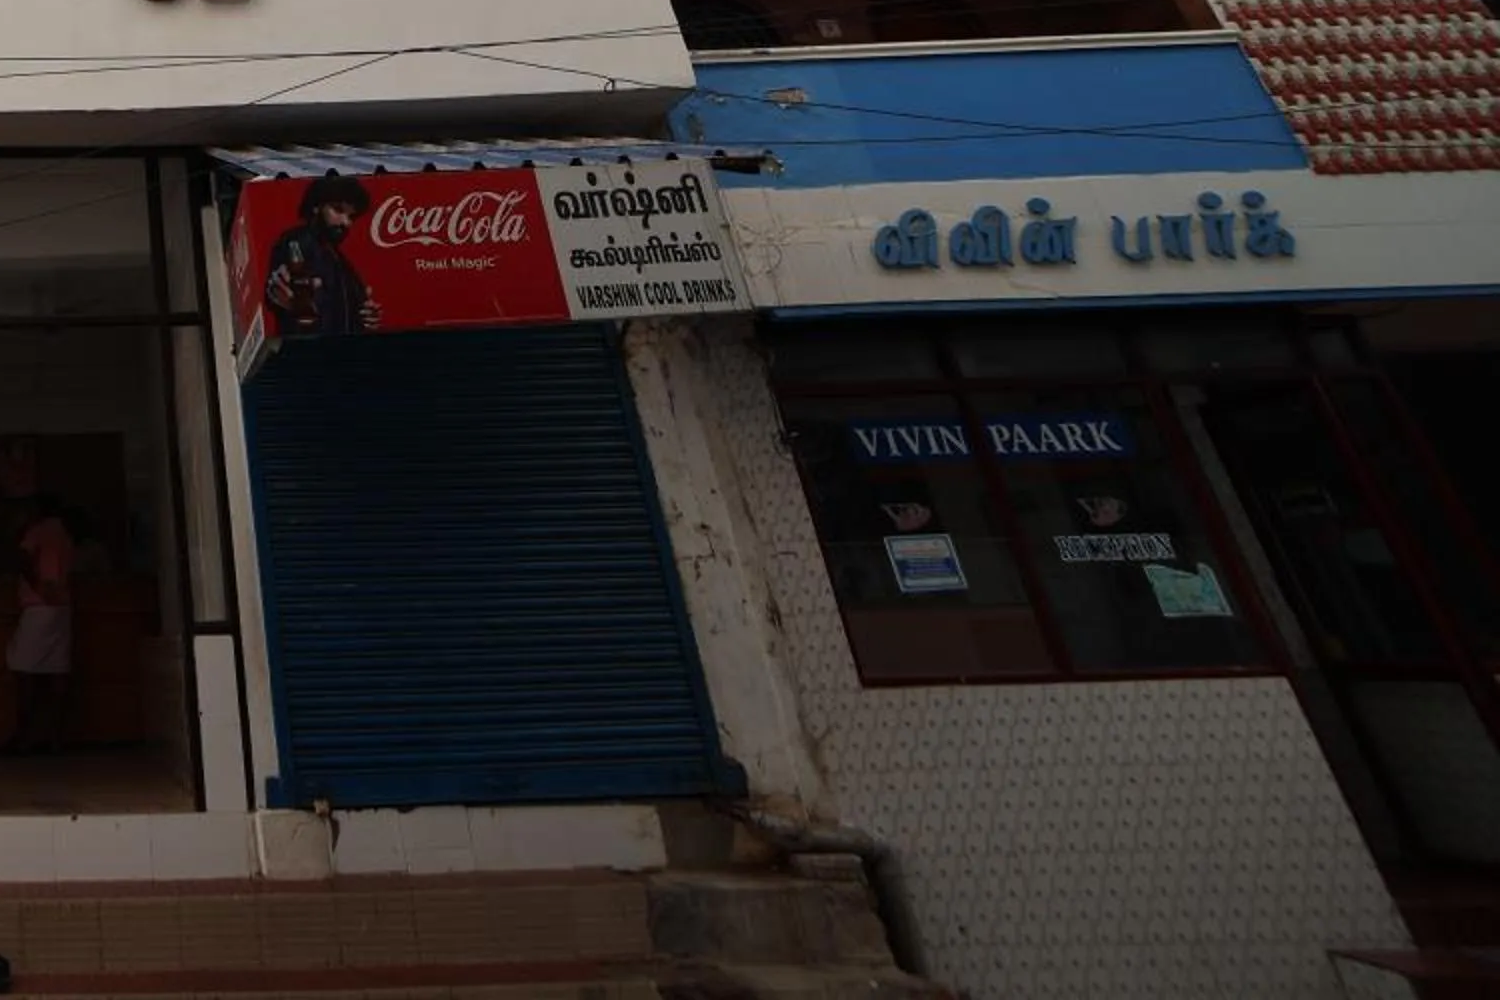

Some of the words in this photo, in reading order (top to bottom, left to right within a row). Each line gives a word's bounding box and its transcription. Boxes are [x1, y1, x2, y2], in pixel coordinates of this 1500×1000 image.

[370, 190, 528, 248] Coca-Cola
[874, 197, 1077, 269] விவின்
[1110, 191, 1295, 262] பார்க்
[415, 258, 450, 271] Real
[451, 255, 497, 271] Magic
[577, 283, 644, 309] VARSHINI
[644, 281, 683, 305] COOL
[683, 278, 737, 303] DRINKS
[854, 424, 970, 457] VIVIN
[987, 420, 1124, 455] PAARK
